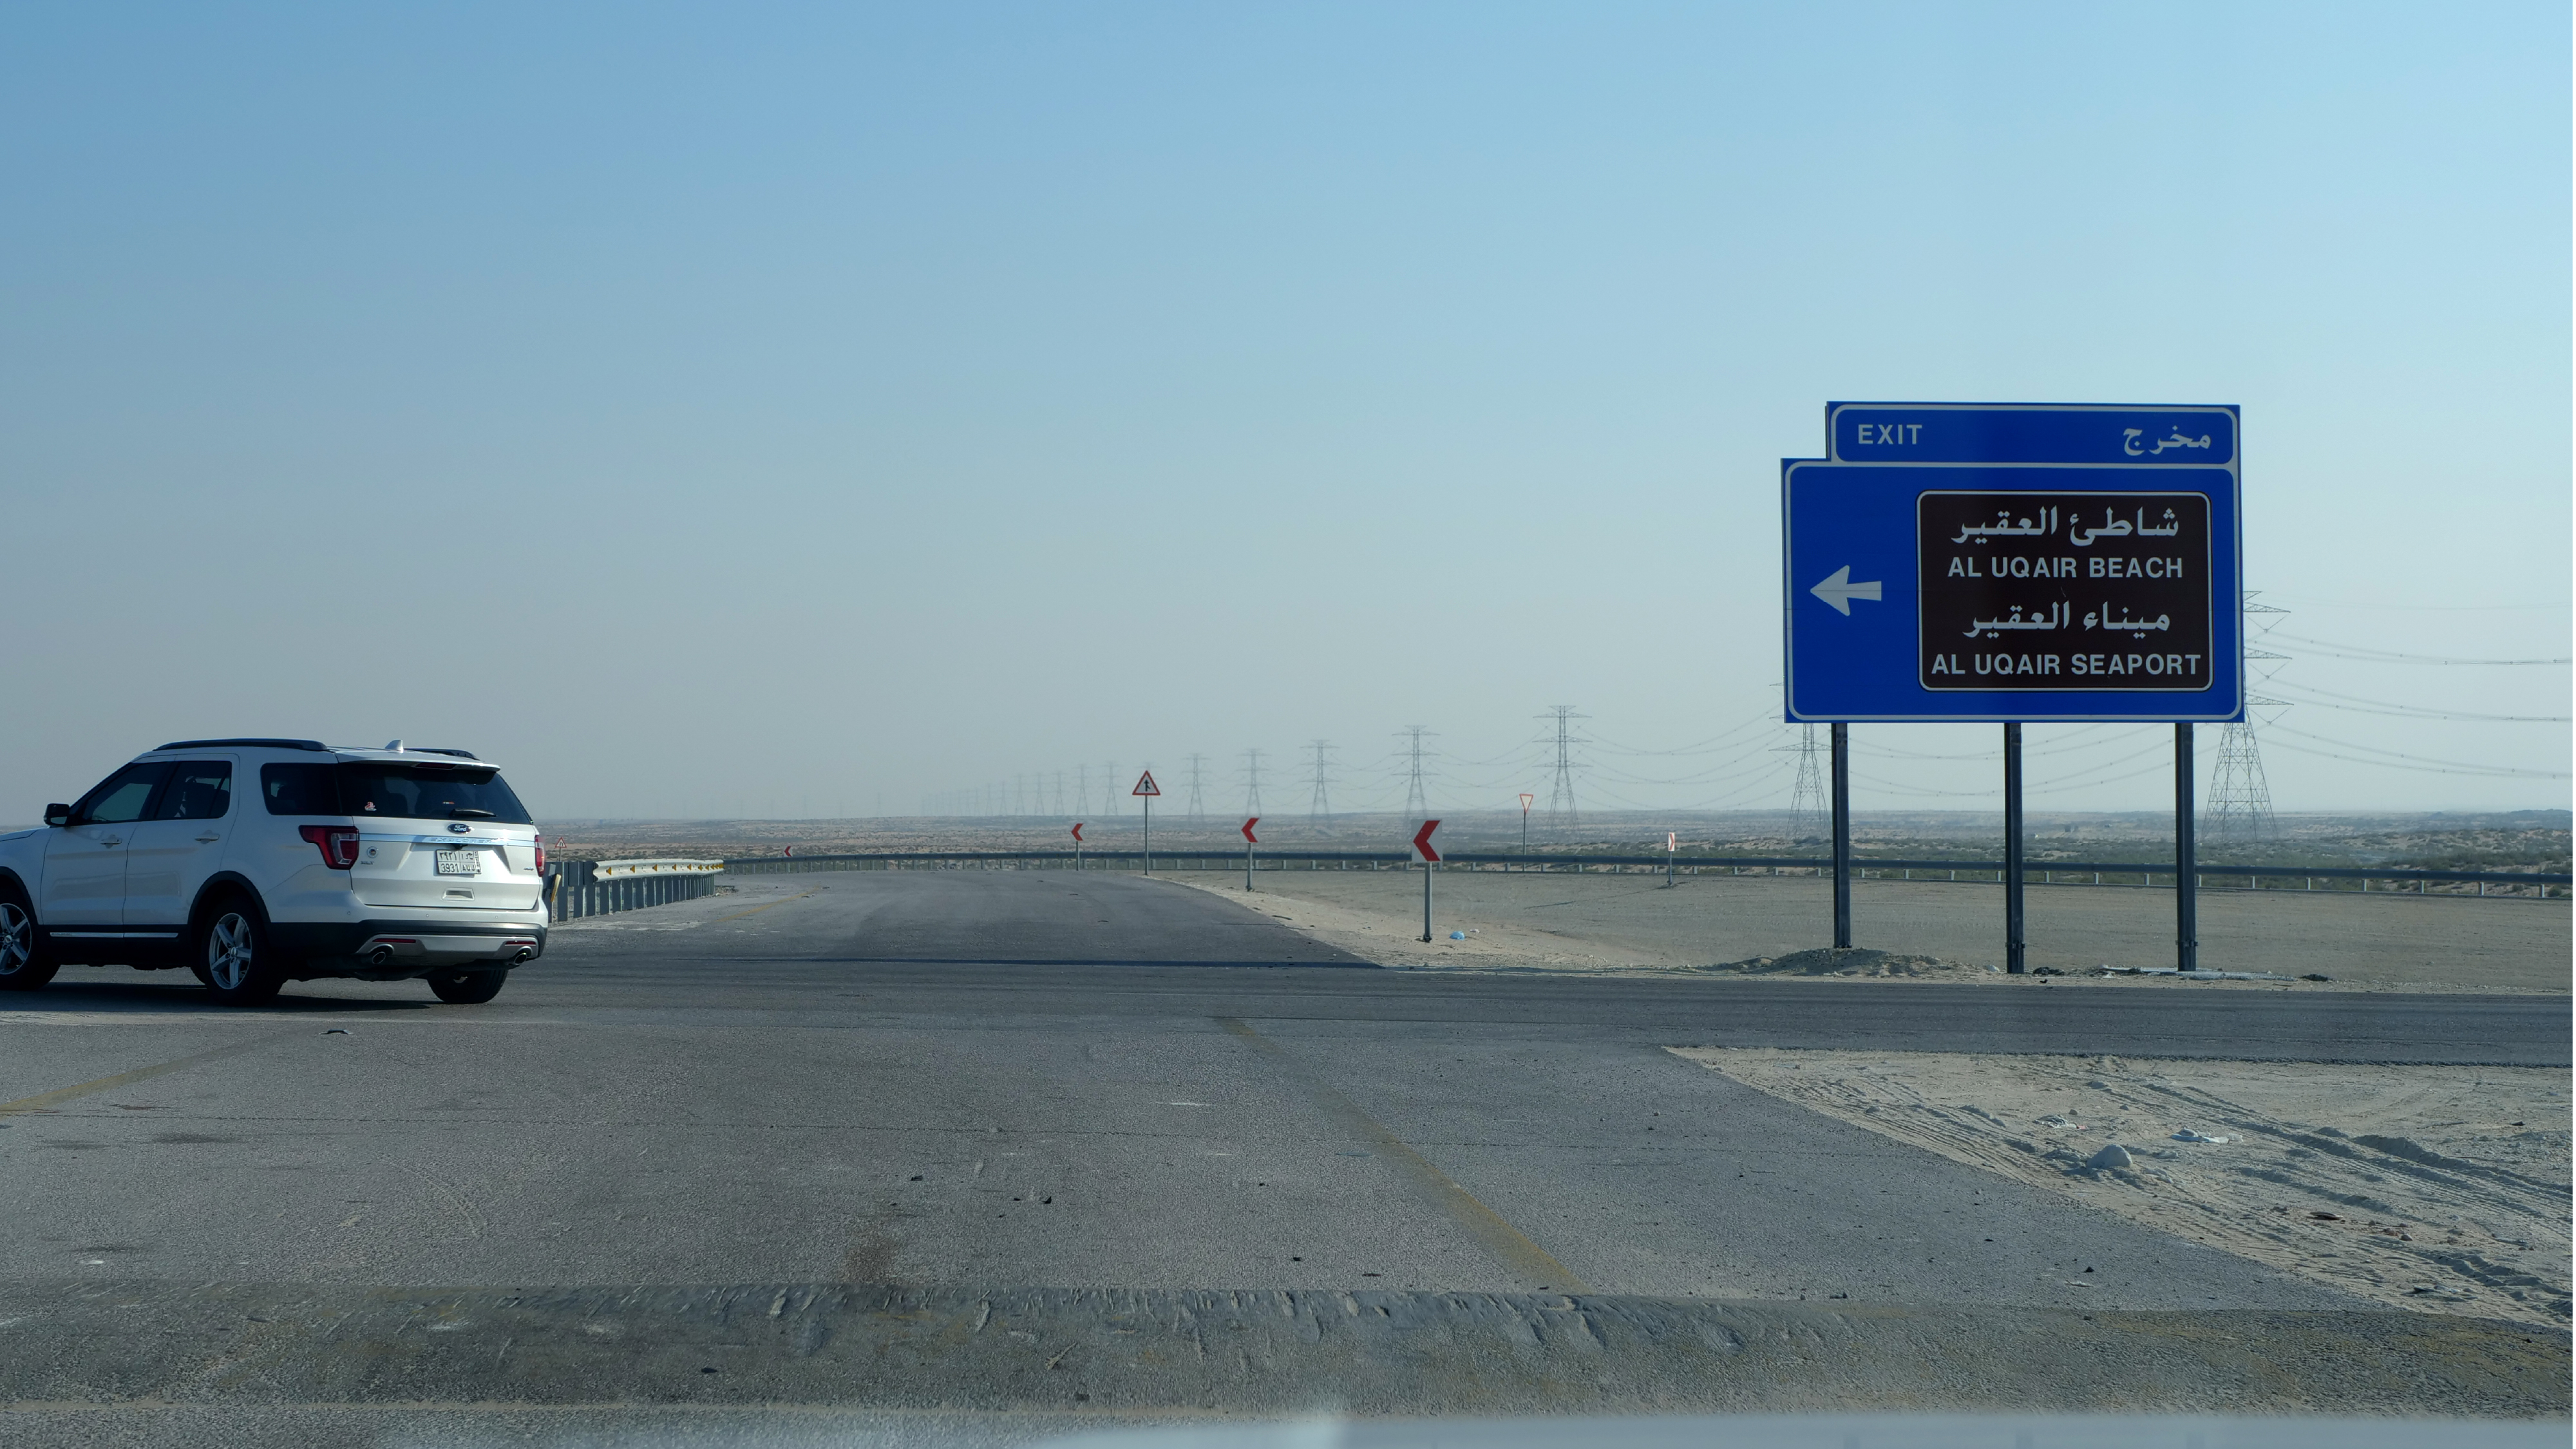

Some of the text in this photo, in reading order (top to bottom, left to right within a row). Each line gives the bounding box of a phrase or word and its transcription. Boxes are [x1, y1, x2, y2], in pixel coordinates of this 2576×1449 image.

[1858, 424, 1922, 444] EXIT
[2123, 426, 2211, 456] مخرج
[1951, 506, 2179, 546] شاطئ العقير
[1948, 556, 2183, 578] AL UQAIR BEACH
[1963, 600, 2170, 639] ميناء العقير
[1931, 653, 2201, 675] AL UQAIR SEAPORT
[441, 864, 459, 873] 3931
